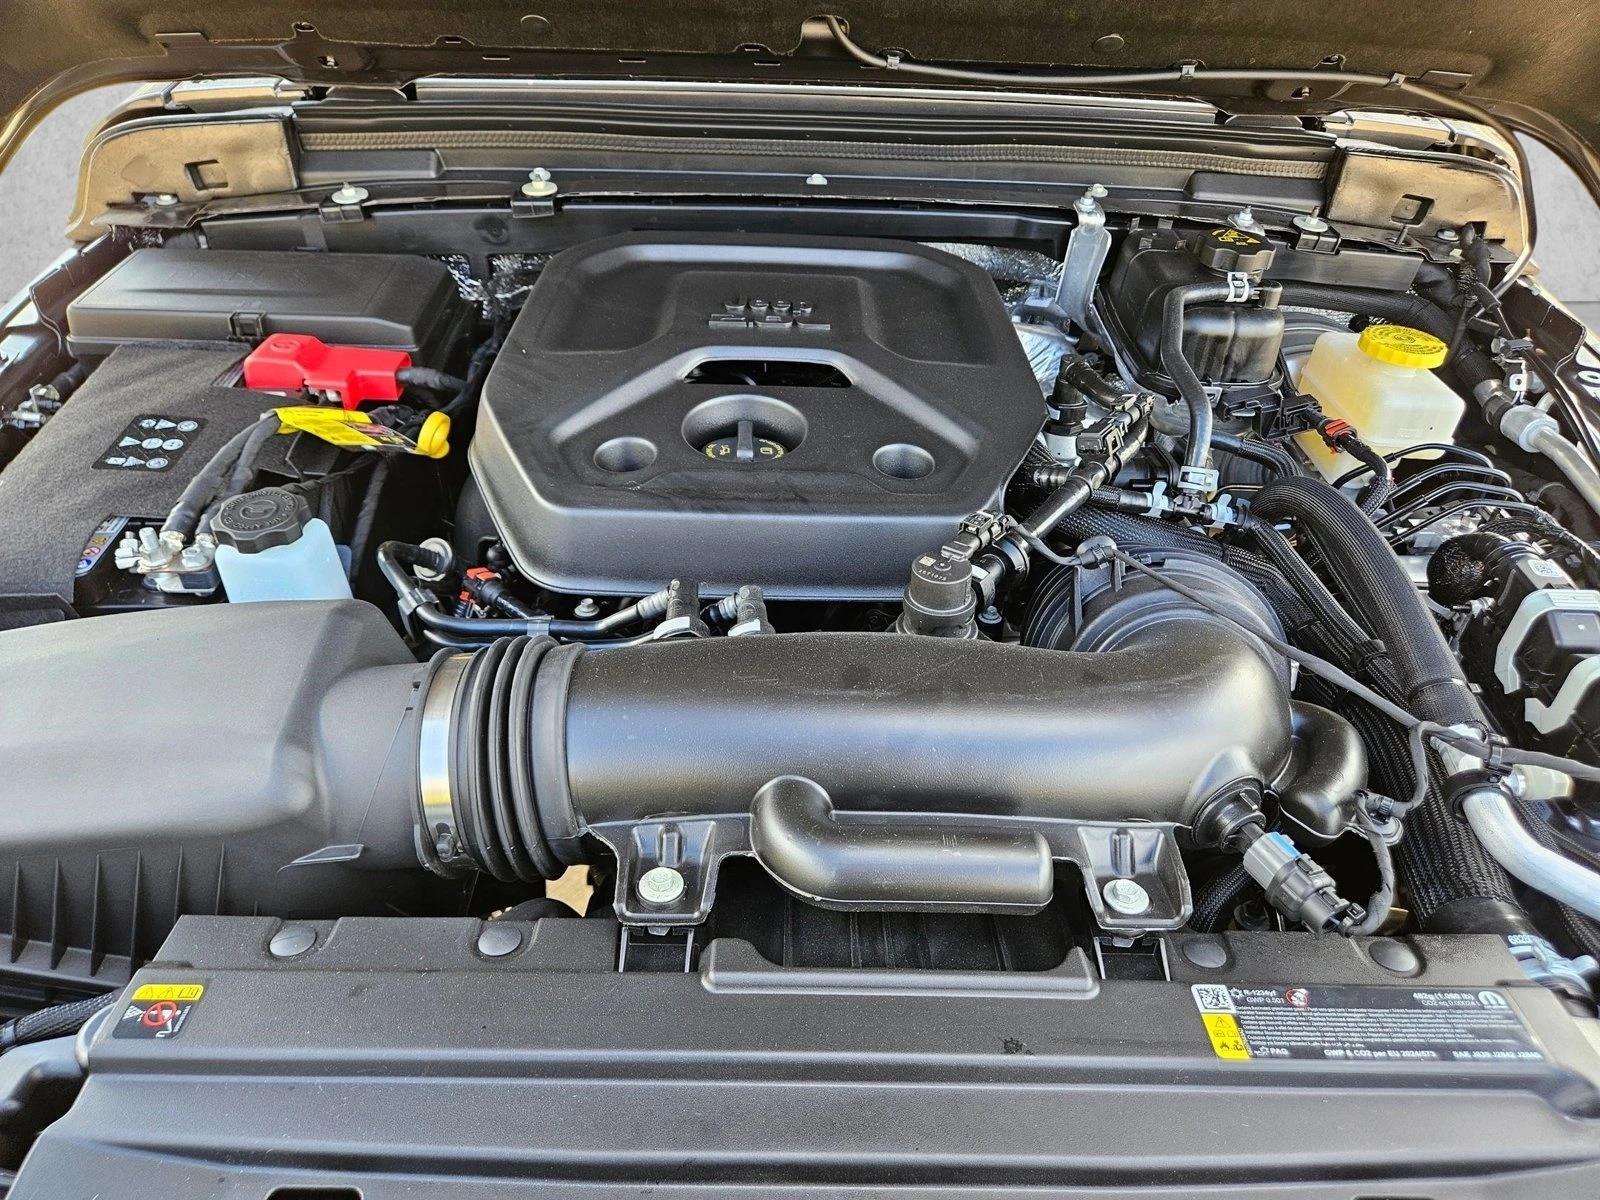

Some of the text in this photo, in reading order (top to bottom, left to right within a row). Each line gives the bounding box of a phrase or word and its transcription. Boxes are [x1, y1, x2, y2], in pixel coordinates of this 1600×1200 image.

[1243, 989, 1276, 998] R-1234yf
[1246, 996, 1265, 1004] GWP
[1269, 1047, 1289, 1056] PAG
[1323, 1049, 1345, 1058] GWP
[1353, 1049, 1372, 1058] CO2
[1372, 1050, 1387, 1059] per
[1387, 1050, 1400, 1058] EU
